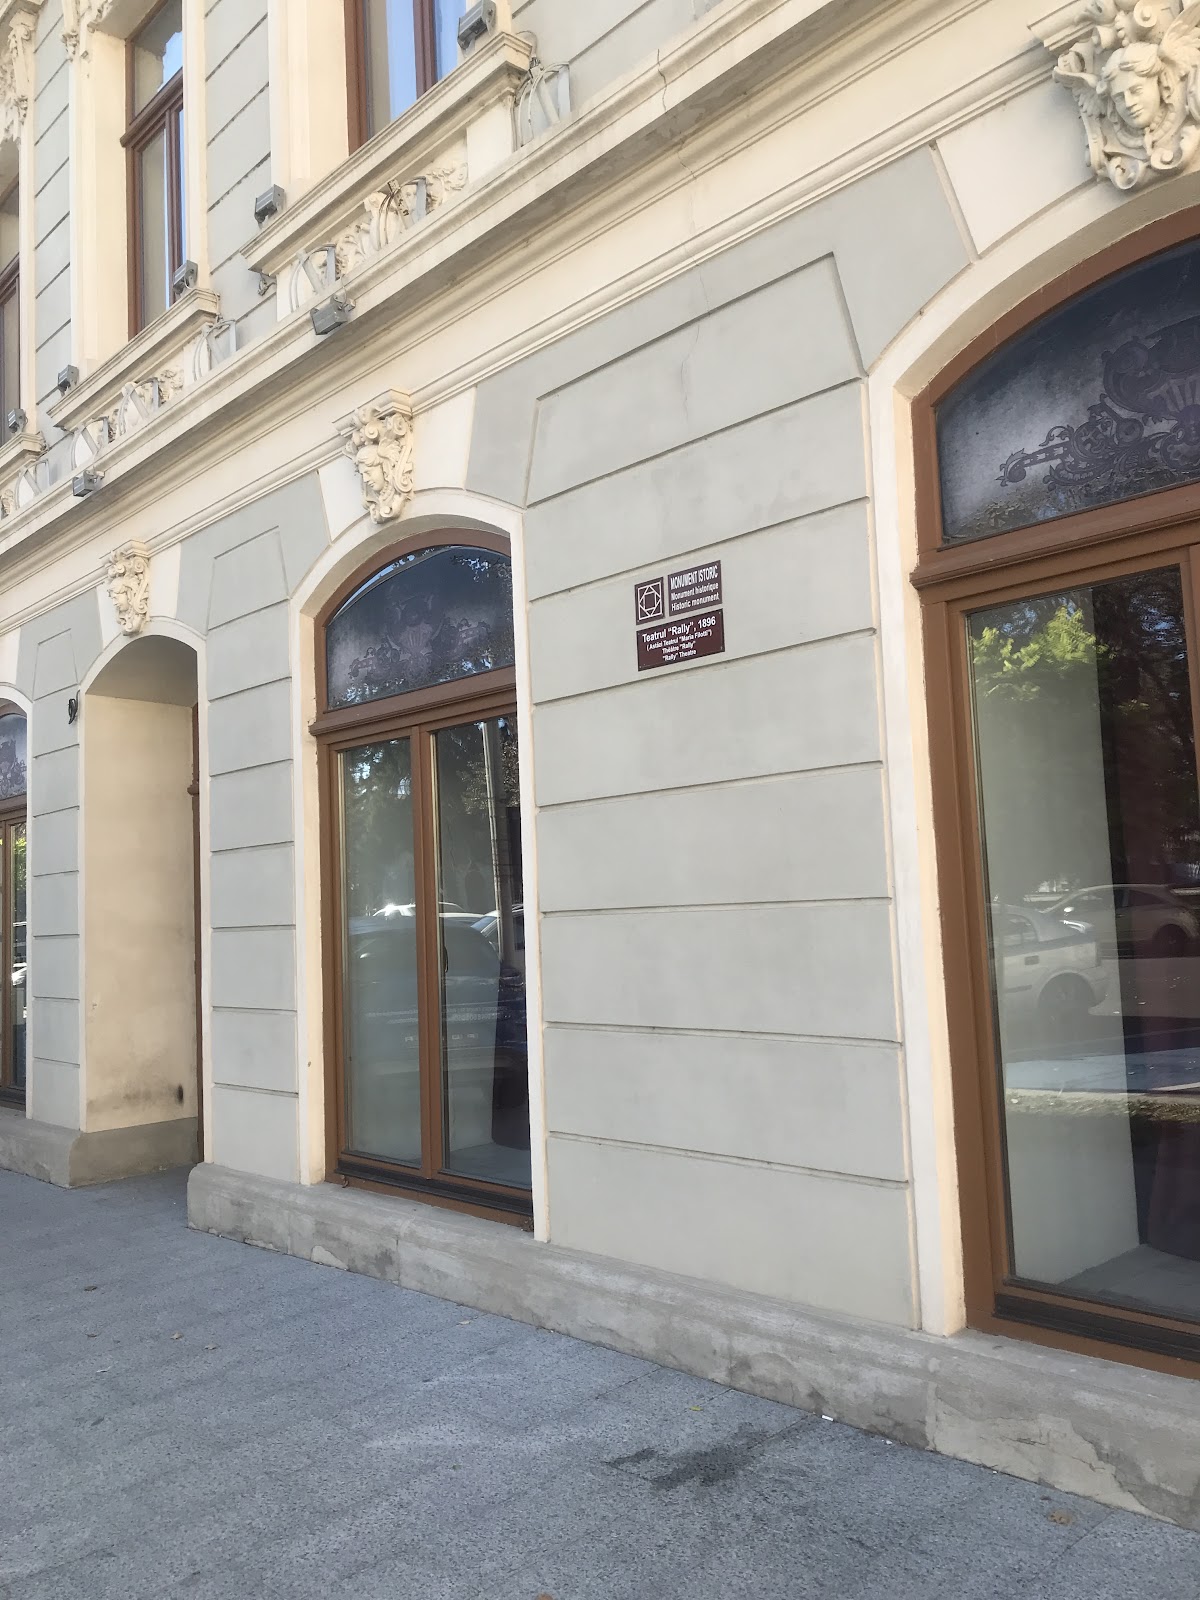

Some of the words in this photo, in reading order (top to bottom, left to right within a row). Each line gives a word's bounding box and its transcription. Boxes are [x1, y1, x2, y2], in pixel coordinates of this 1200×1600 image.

[670, 570, 698, 590] MONUMENT
[698, 565, 718, 582] ISTORIC
[671, 587, 695, 601] Monument
[695, 582, 719, 594] historique
[671, 600, 691, 611] Historic
[691, 592, 719, 606] monument
[642, 629, 666, 643] Teatrul
[698, 616, 716, 629] 1896
[663, 637, 679, 646] Teatrul
